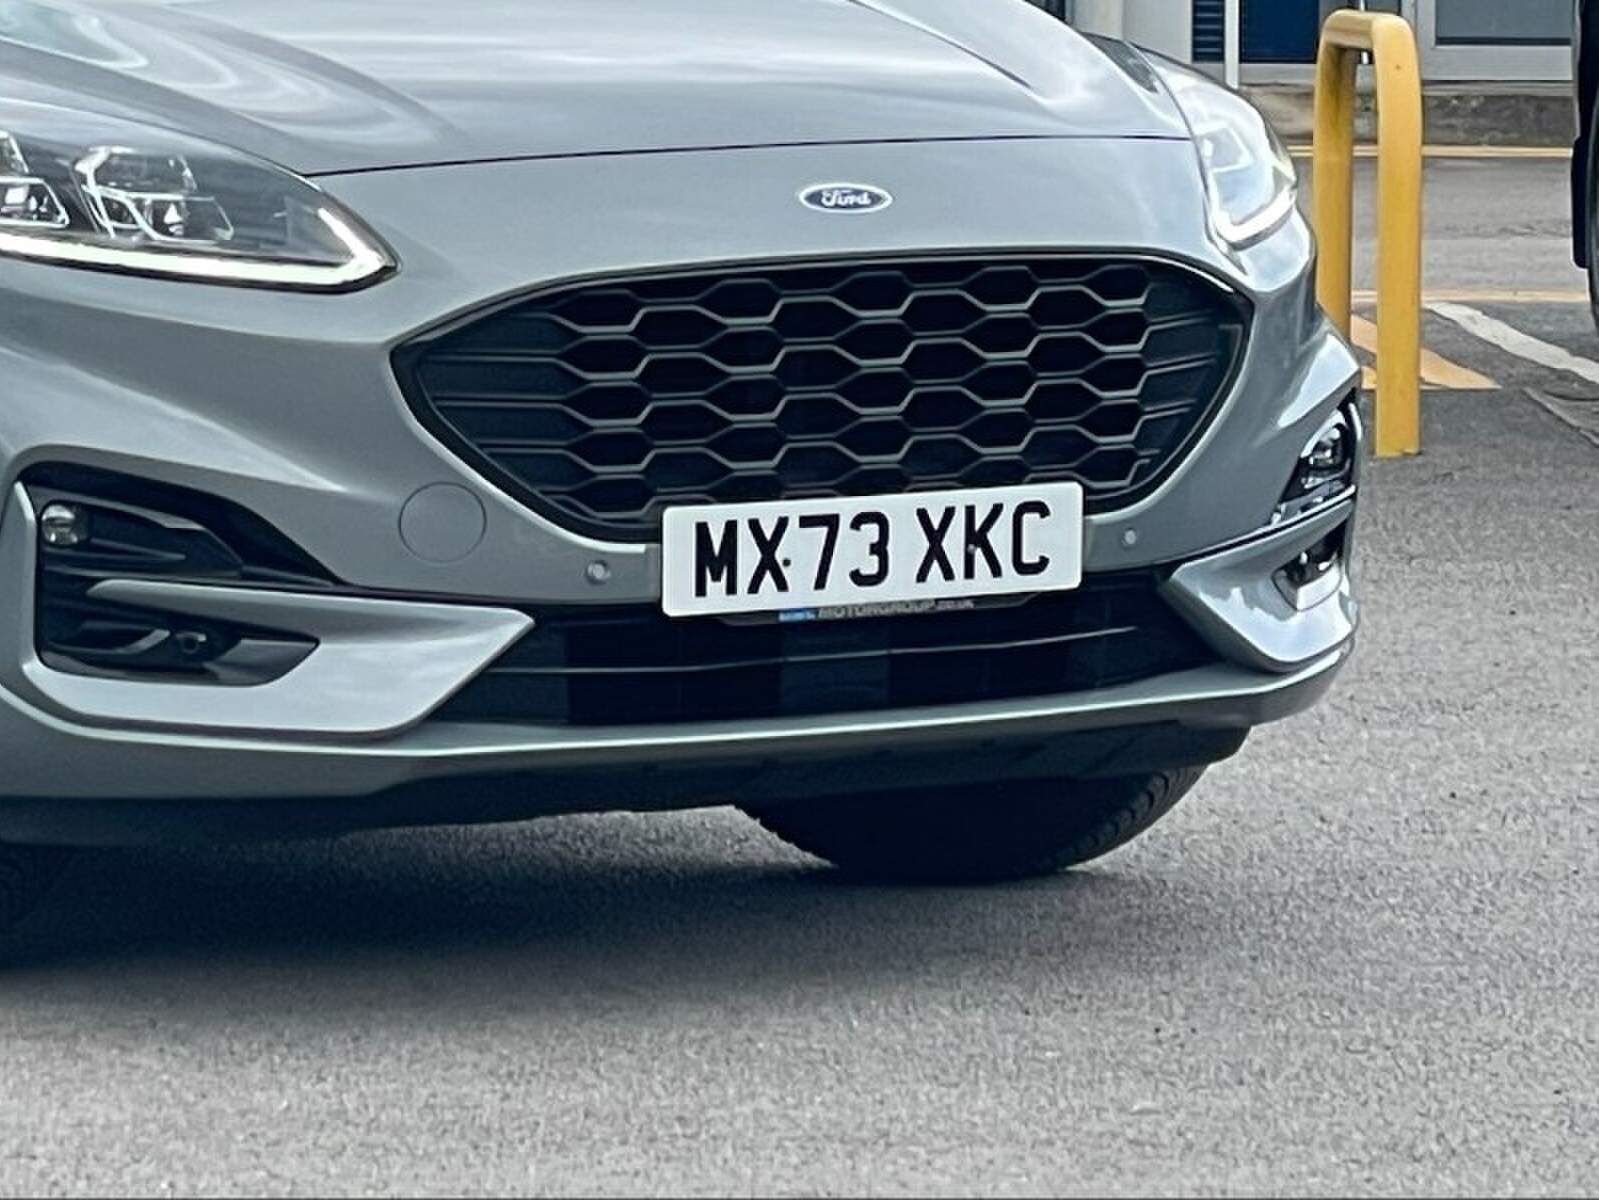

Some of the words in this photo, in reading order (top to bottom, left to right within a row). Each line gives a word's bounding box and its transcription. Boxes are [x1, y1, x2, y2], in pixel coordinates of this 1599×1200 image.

[821, 189, 872, 207] Ford
[694, 510, 891, 599] MX73
[915, 499, 1052, 584] XKC
